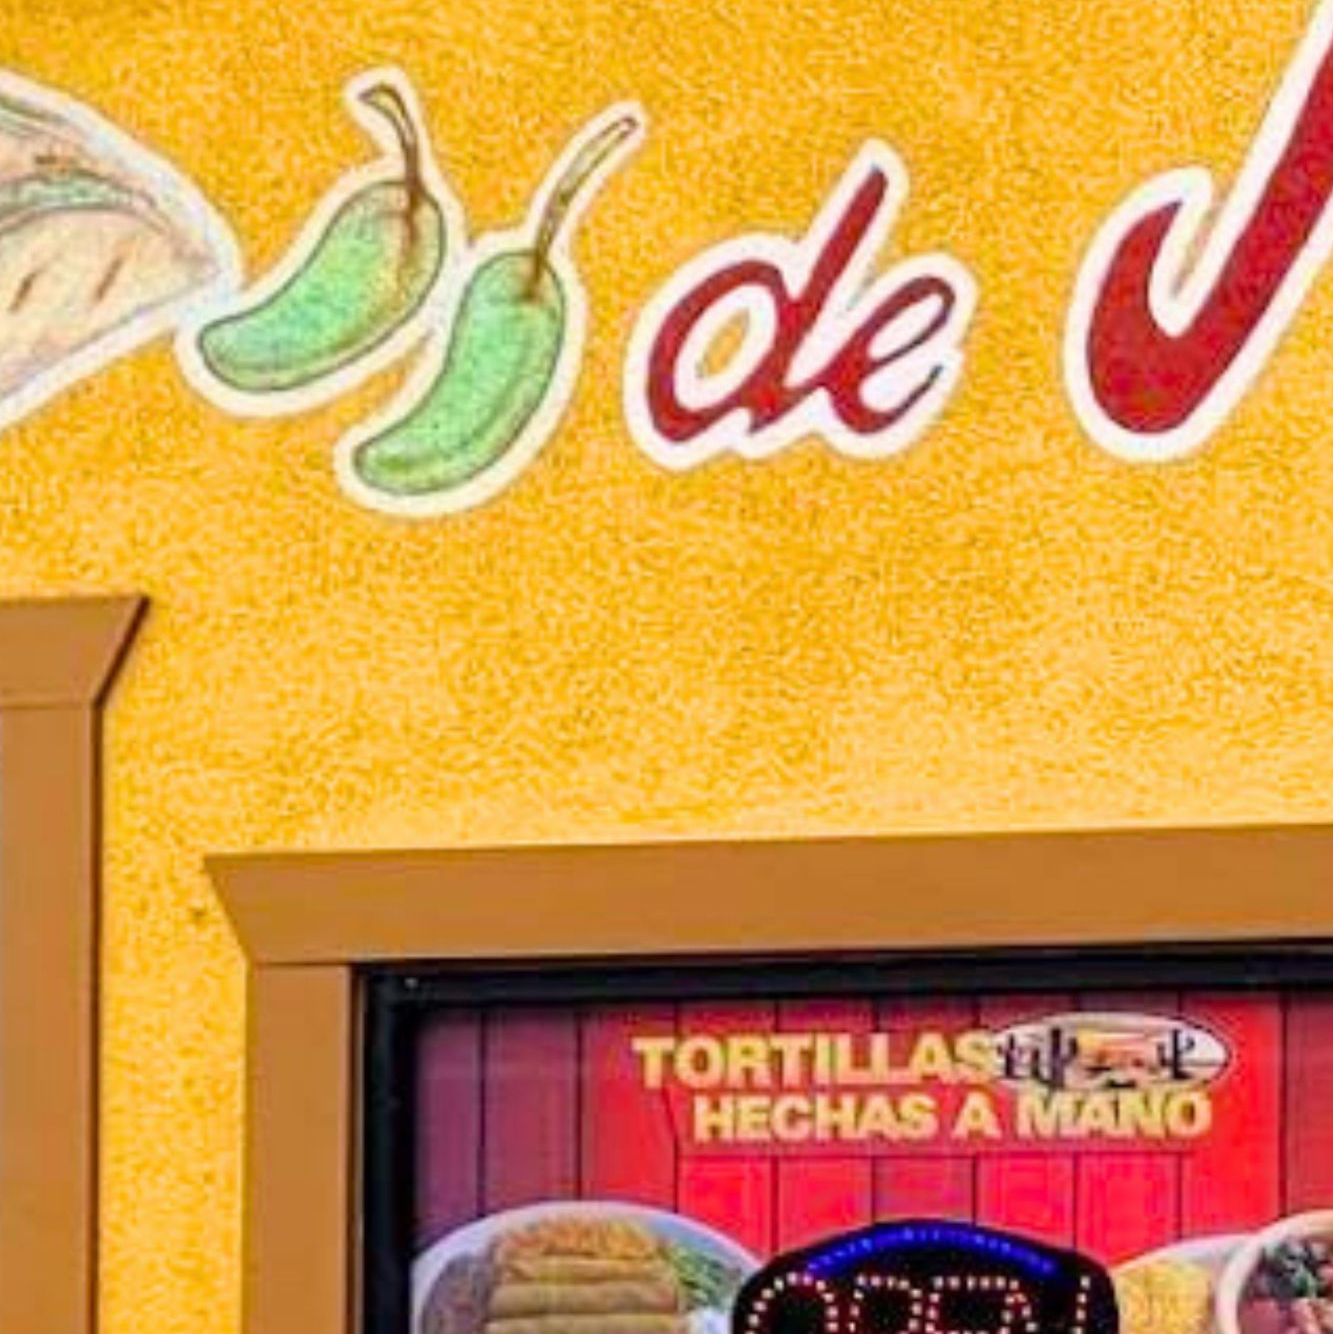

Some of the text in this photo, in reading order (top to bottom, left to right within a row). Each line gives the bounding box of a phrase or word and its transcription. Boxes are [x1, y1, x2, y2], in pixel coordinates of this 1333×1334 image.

[622, 141, 977, 467] de
[632, 1032, 1000, 1089] TORTILLAS
[694, 1087, 1214, 1142] HECHAS A MANO
